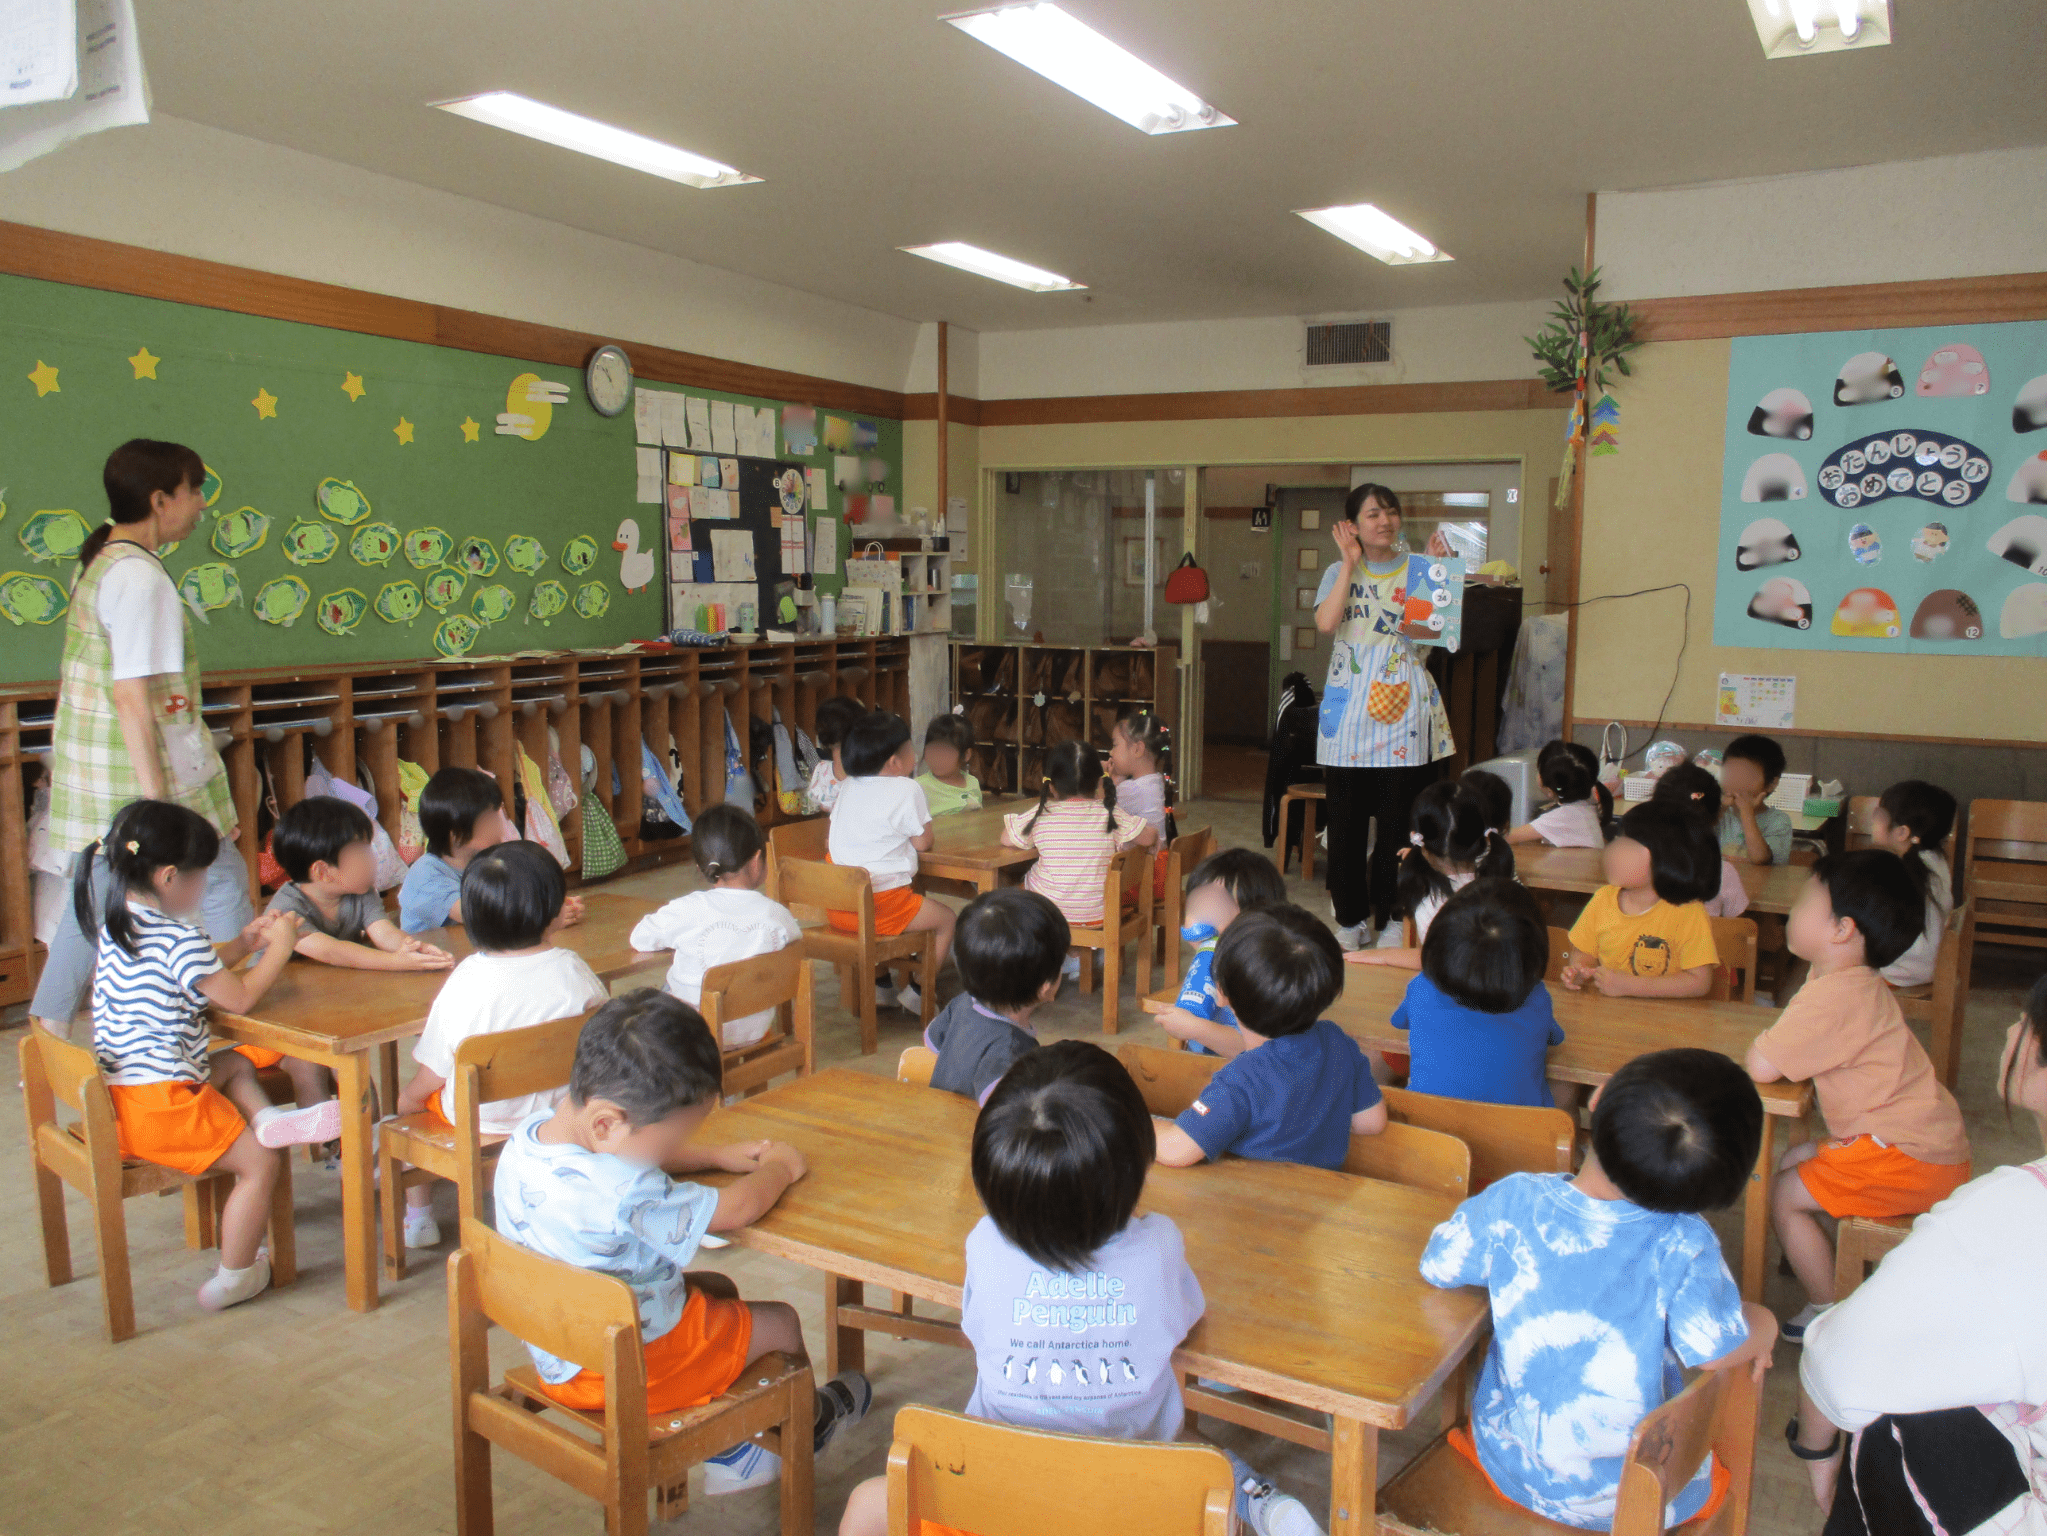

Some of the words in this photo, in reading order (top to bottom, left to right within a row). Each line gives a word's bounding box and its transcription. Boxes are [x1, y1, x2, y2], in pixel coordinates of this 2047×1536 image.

[1839, 473, 1966, 506] おめでとう
[1967, 627, 1978, 637] 12
[1025, 1271, 1125, 1299] Adelie
[1012, 1298, 1137, 1333] Penguin
[1010, 1338, 1024, 1348] We
[1026, 1339, 1045, 1349] call
[1048, 1340, 1099, 1350] Antarctica
[1102, 1339, 1132, 1348] home.
